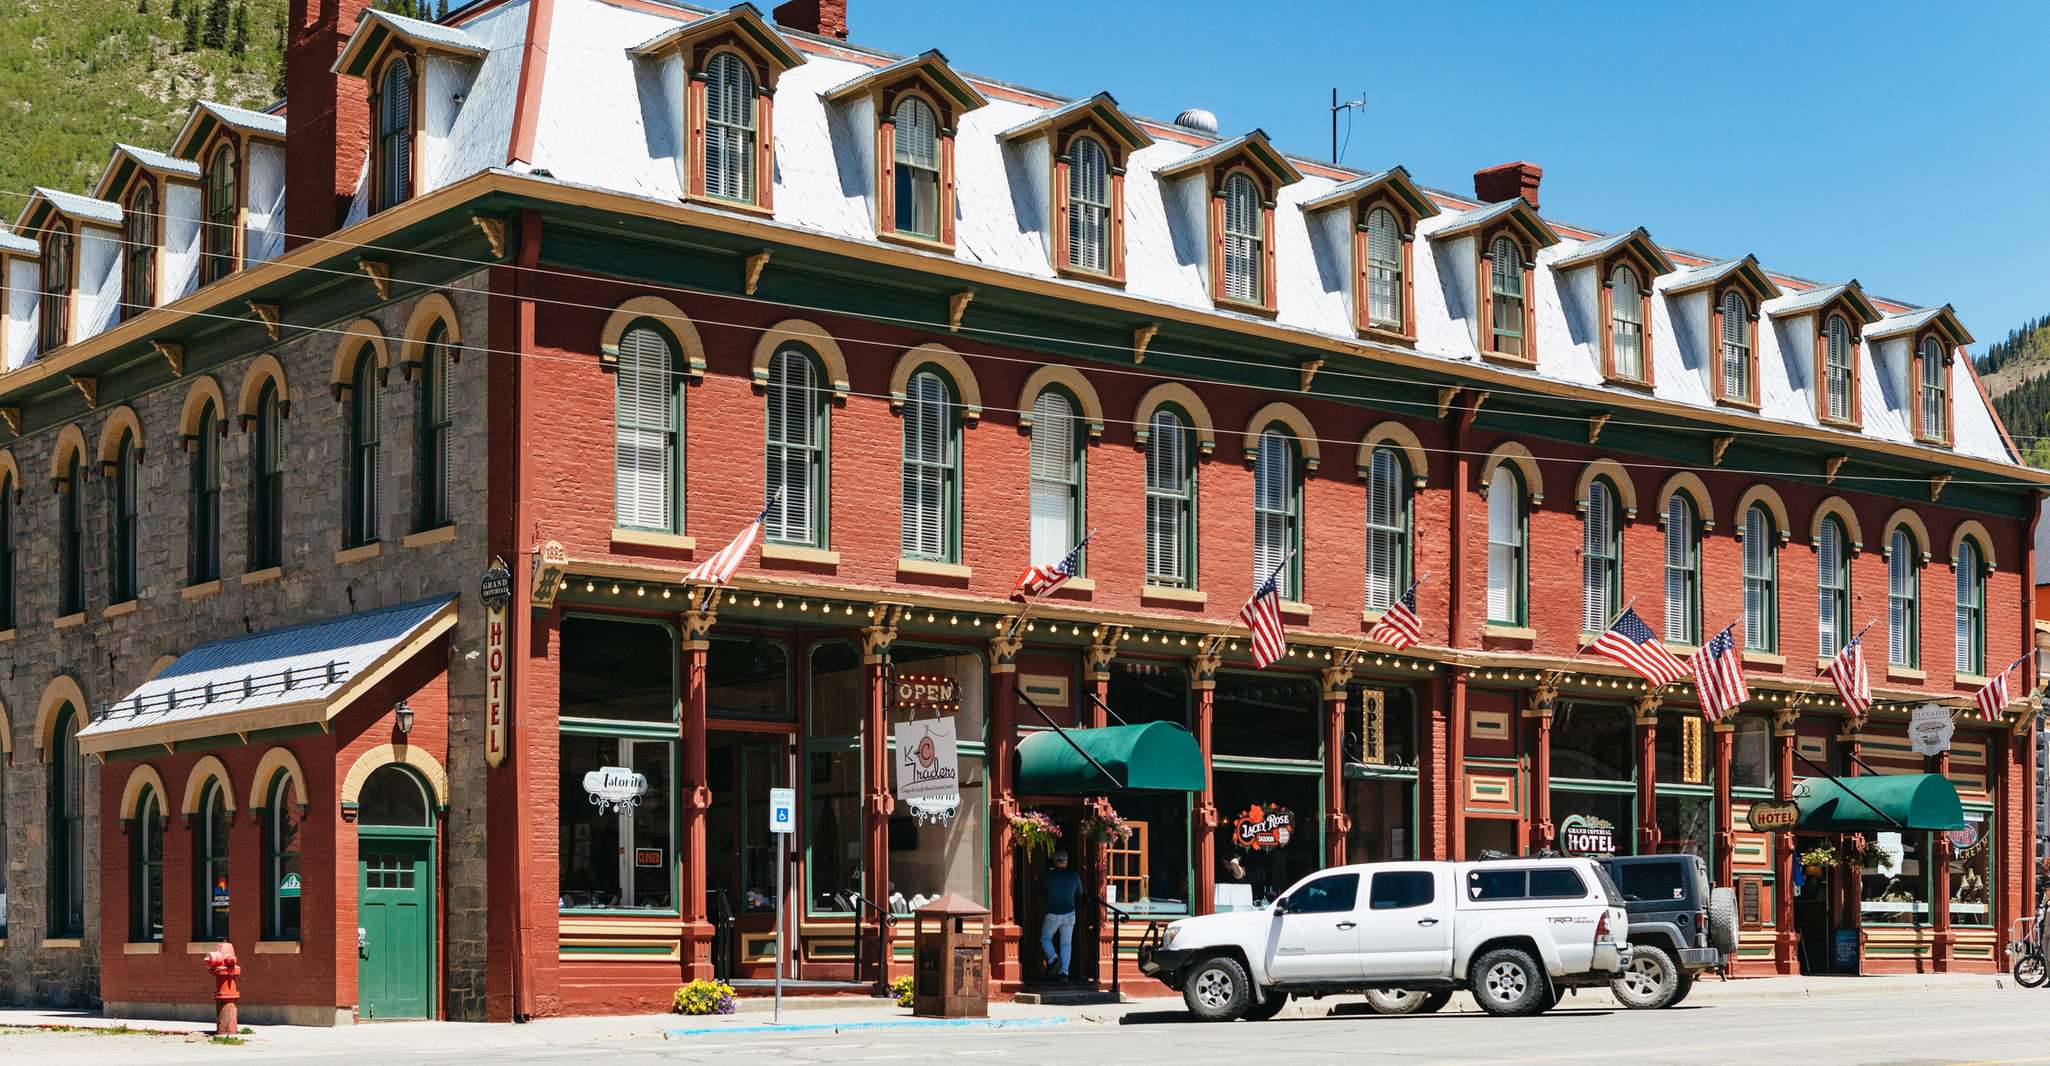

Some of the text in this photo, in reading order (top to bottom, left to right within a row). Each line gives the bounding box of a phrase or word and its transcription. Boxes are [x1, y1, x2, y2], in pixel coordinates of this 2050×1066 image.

[482, 579, 507, 590] GRAND
[483, 588, 508, 597] IMPERIAL
[490, 622, 503, 753] HOTEL
[900, 684, 952, 701] OPEN
[1368, 698, 1377, 758] OPEN
[904, 756, 955, 783] Traders
[1242, 814, 1289, 838] LACEY ROSE
[1757, 812, 1794, 824] HOTEL
[1568, 834, 1615, 852] HOTEL
